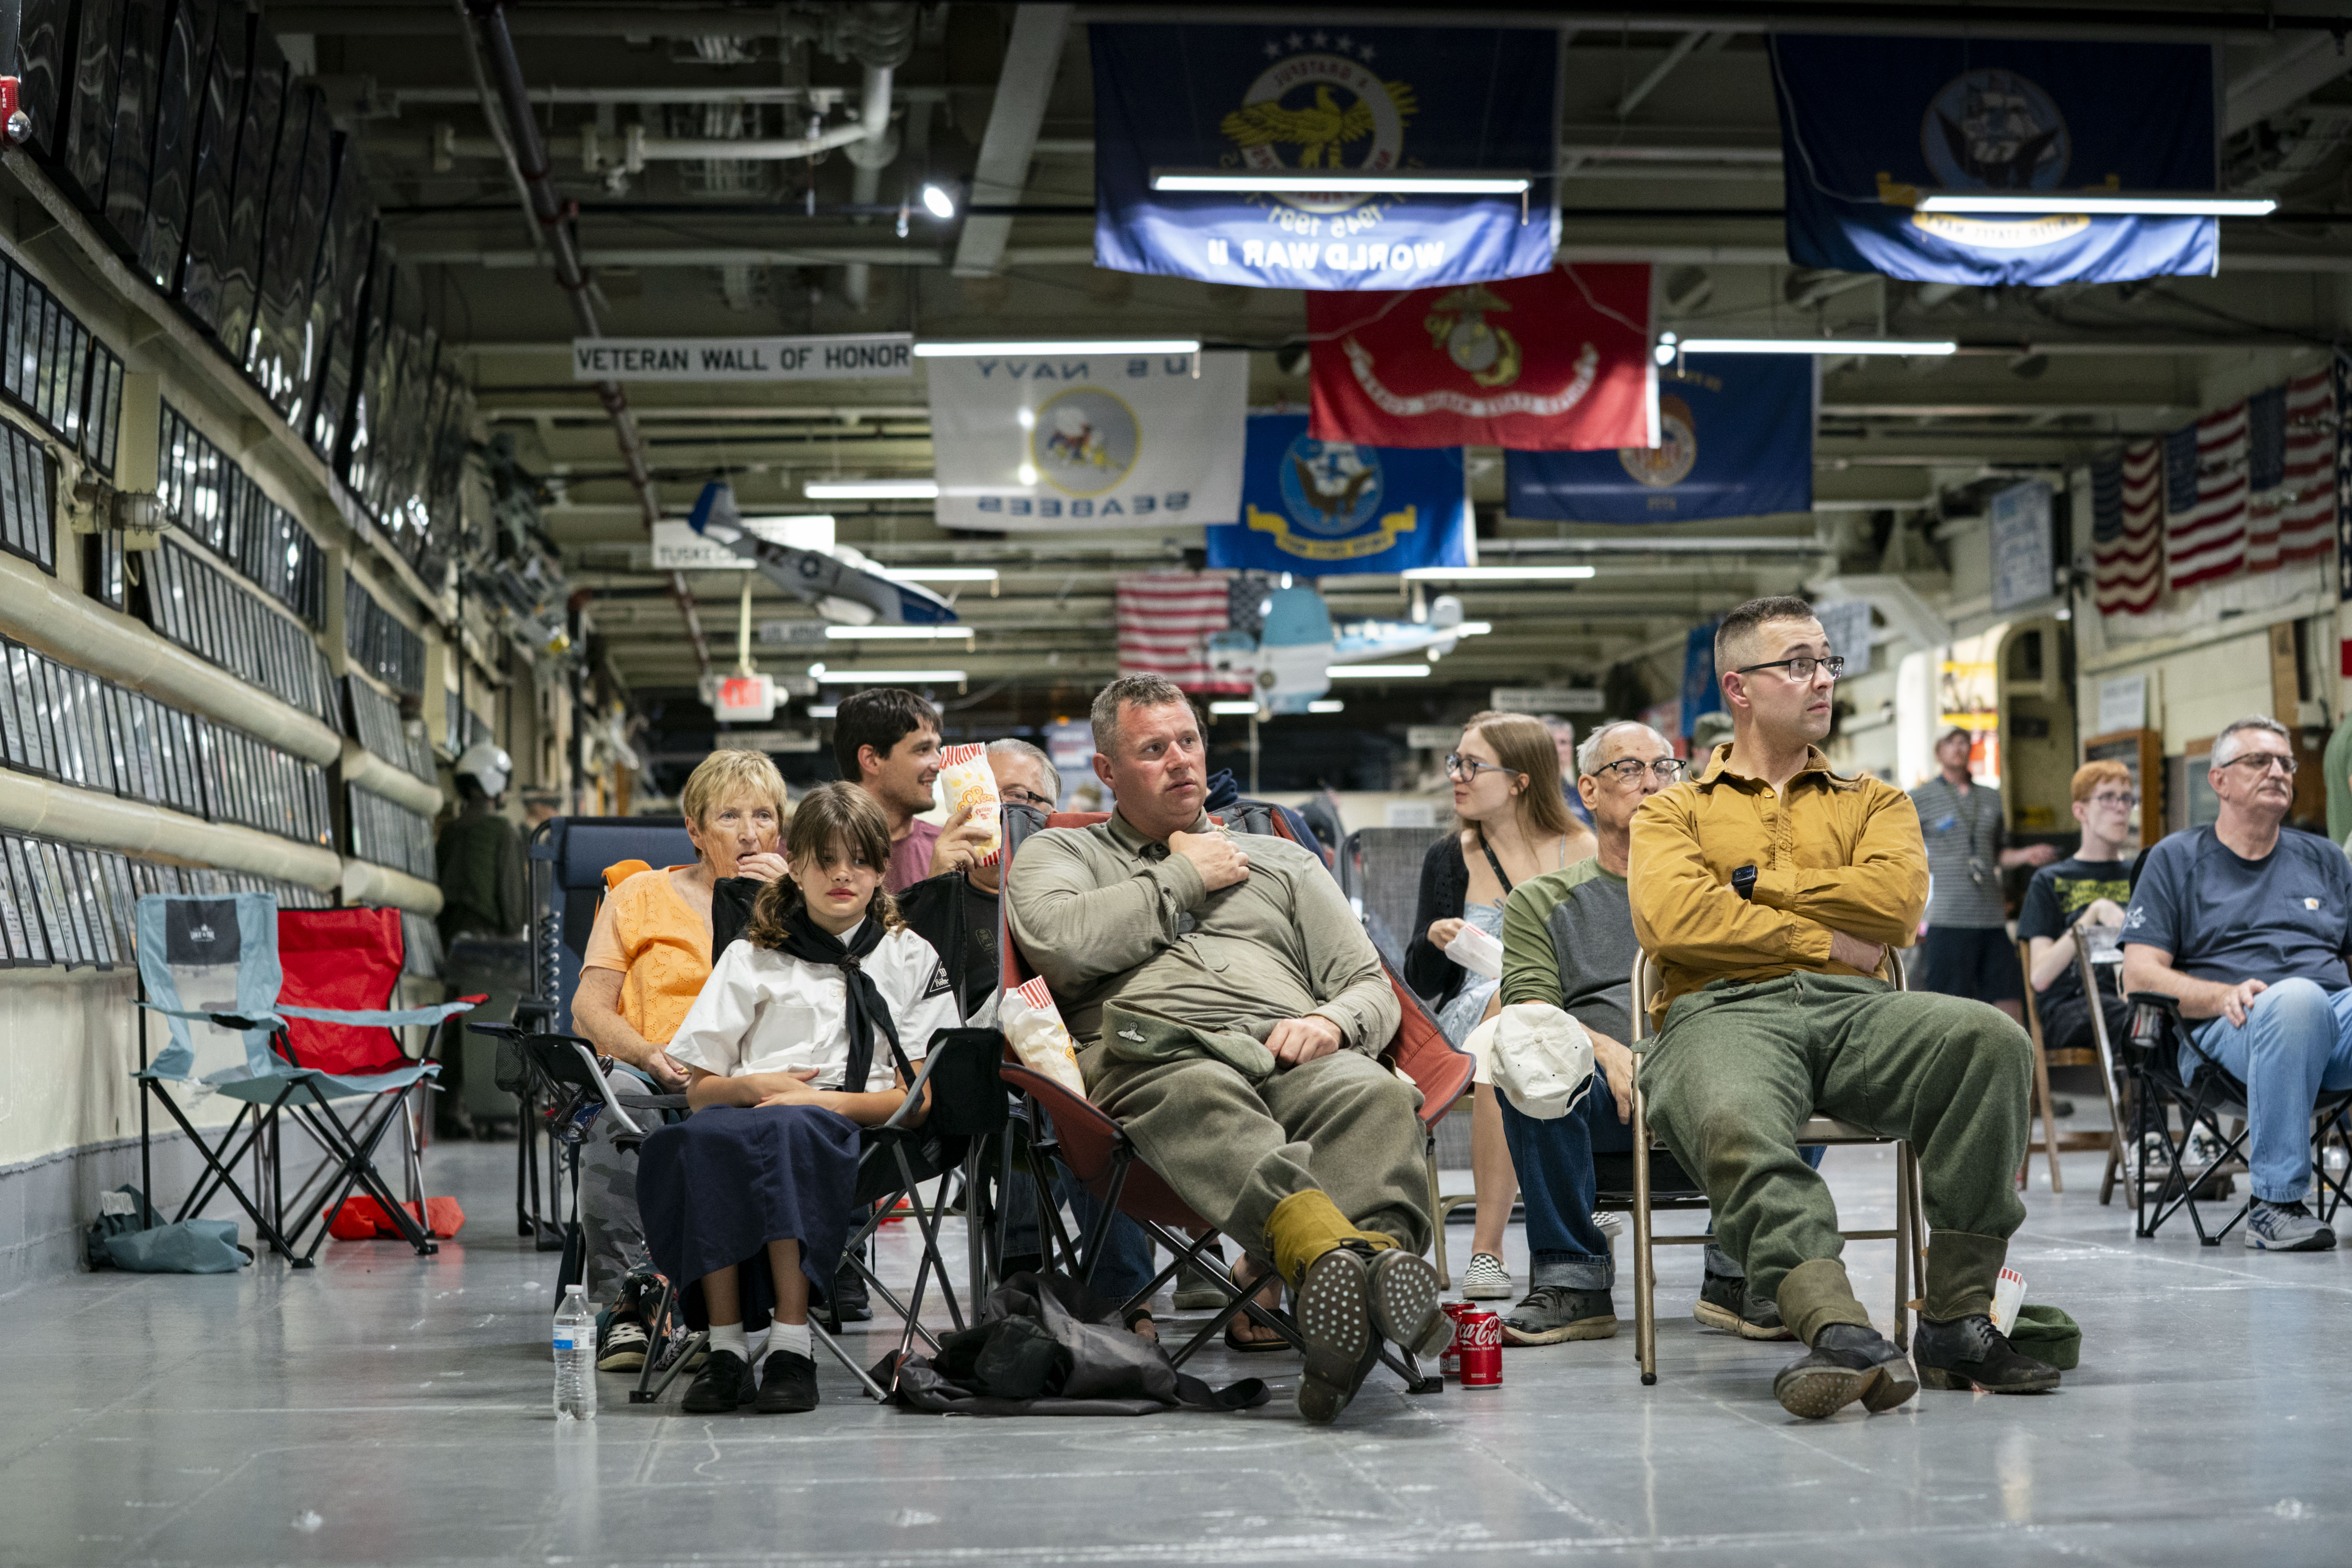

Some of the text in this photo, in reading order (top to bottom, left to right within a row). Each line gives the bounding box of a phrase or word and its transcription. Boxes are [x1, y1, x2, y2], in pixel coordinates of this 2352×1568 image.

[577, 343, 908, 372] VETERAN WALL OF HONOR
[975, 807, 993, 815] FRESH!
